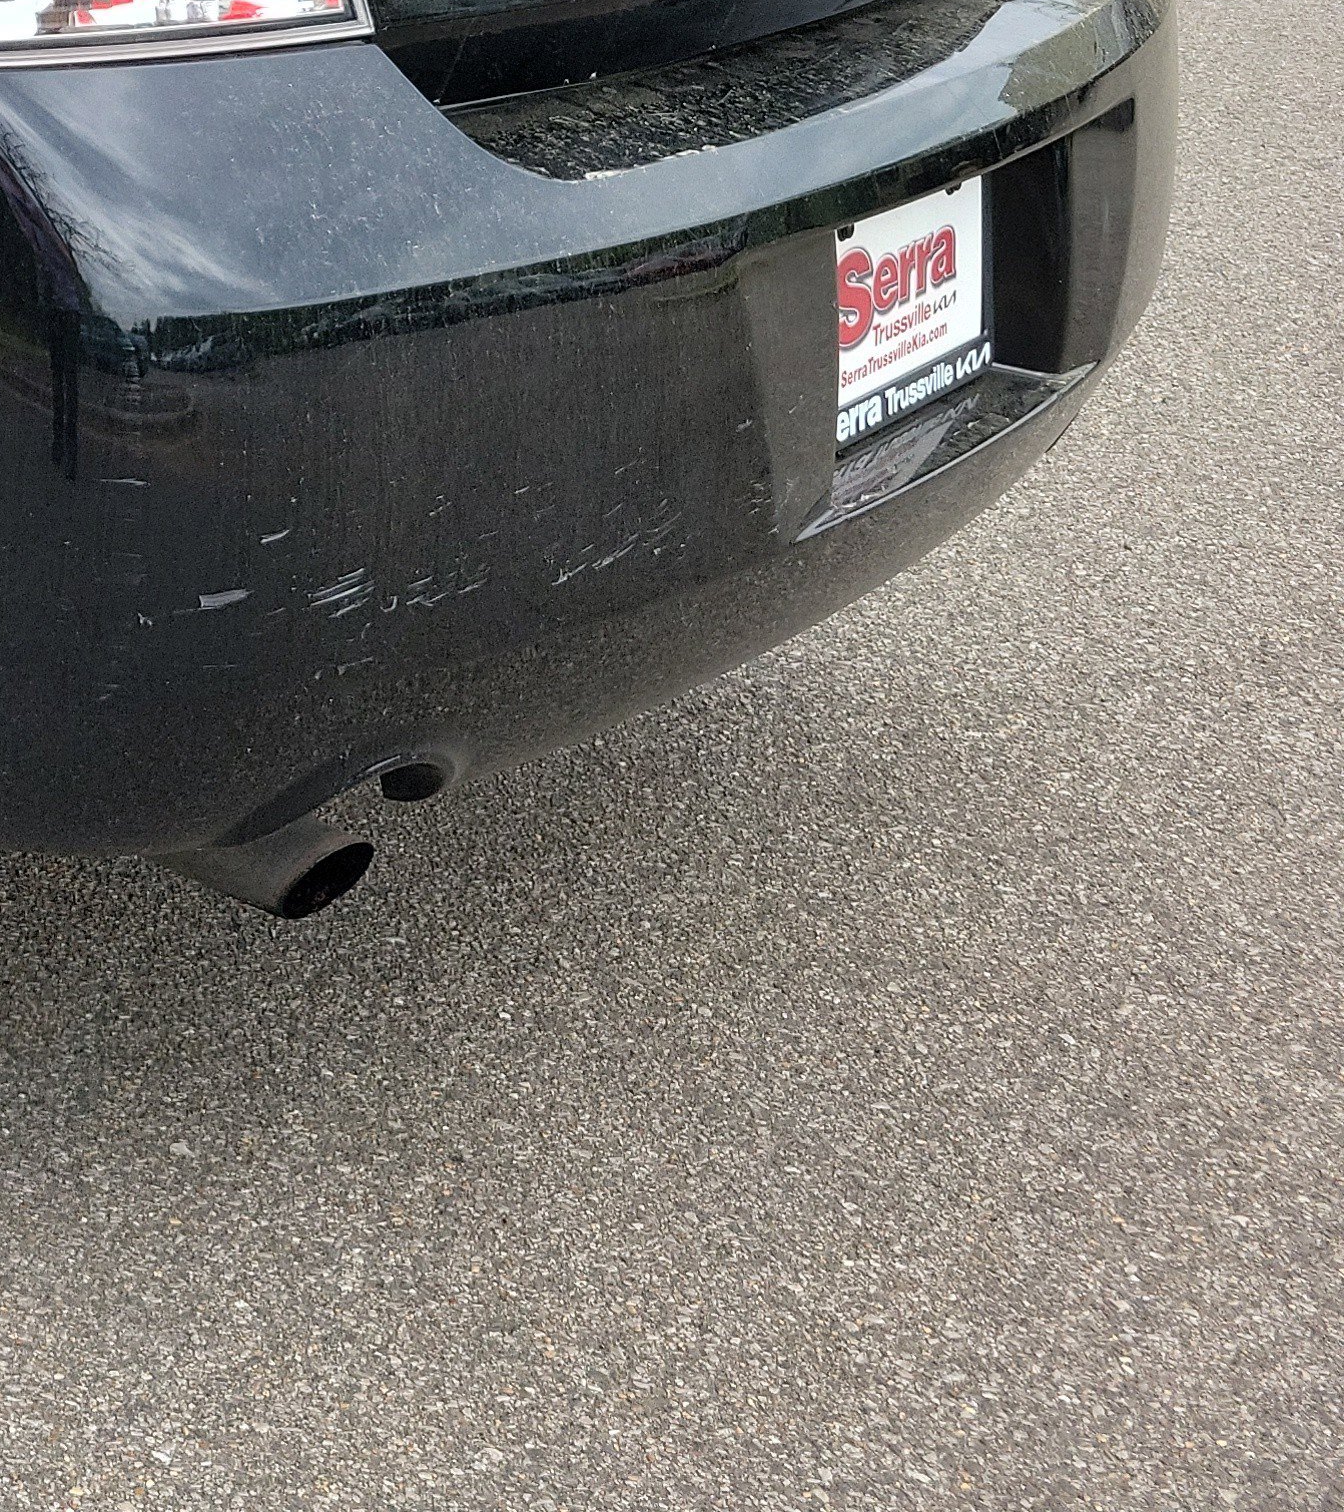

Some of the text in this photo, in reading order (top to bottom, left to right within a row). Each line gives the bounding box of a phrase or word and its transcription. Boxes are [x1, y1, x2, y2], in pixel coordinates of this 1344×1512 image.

[837, 226, 956, 348] Serra
[873, 301, 932, 346] Trussville
[841, 322, 948, 388] SerraTrussvilleKia.com
[836, 395, 883, 442] erra
[885, 362, 952, 416] Trussville
